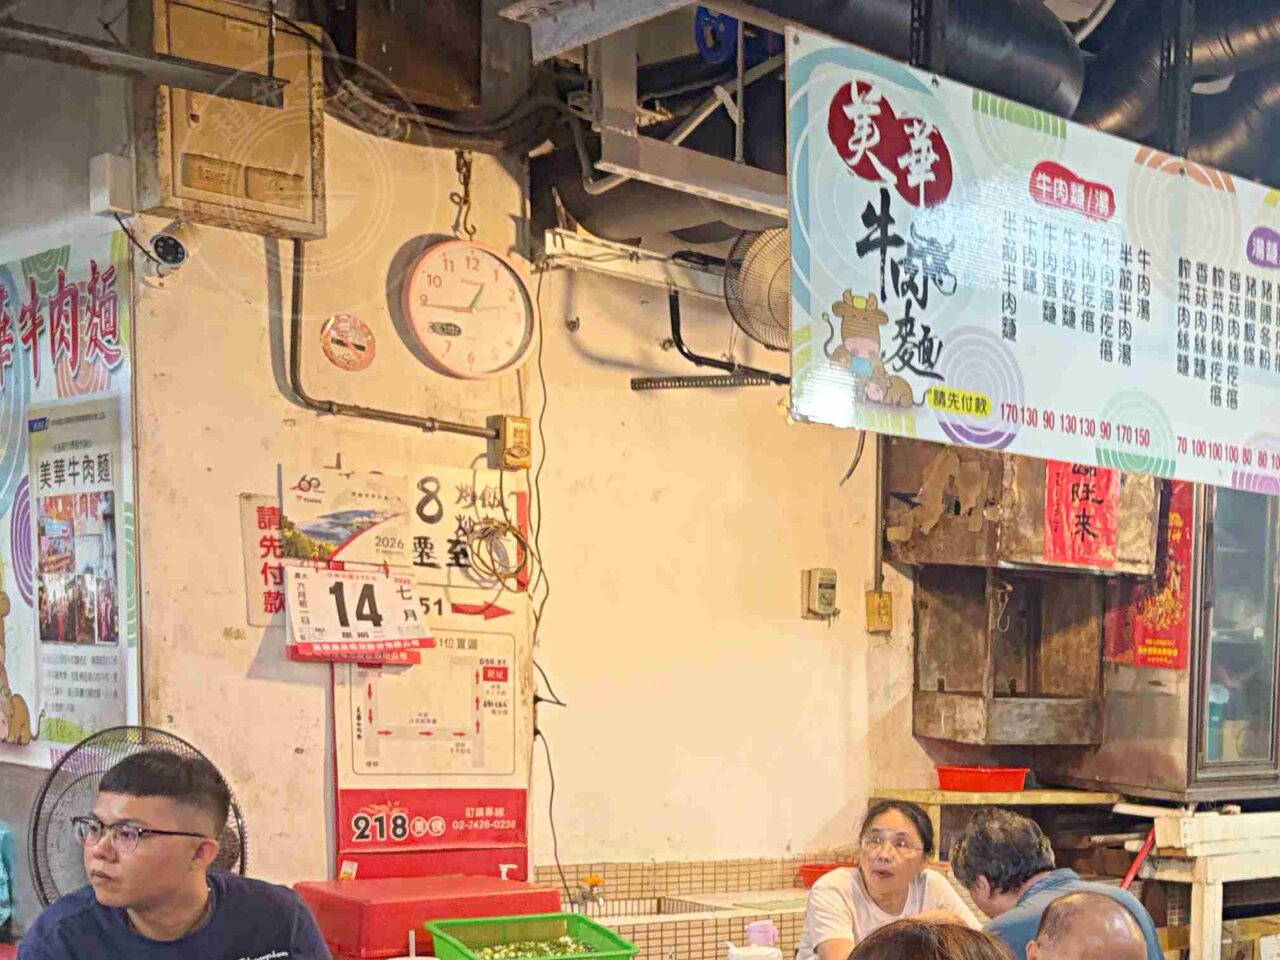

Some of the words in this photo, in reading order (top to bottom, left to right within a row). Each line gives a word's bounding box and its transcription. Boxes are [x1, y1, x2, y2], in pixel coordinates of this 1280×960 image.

[443, 259, 455, 272] 11
[465, 256, 480, 271] 12
[1023, 215, 1038, 294] 牛肉麵
[427, 274, 442, 288] 10
[1137, 247, 1151, 322] 牛肉湯
[933, 389, 988, 415] 請先付款
[1001, 401, 1018, 423] 170
[1020, 405, 1038, 427] 130
[1043, 410, 1055, 430] 90
[1060, 413, 1077, 434] 130
[1080, 418, 1096, 437] 130
[1100, 422, 1111, 440] 90
[1116, 424, 1132, 444] 170
[1134, 428, 1150, 447] 150
[1177, 436, 1188, 454] 70
[1192, 439, 1206, 457] 100
[1208, 442, 1222, 460] 100
[1225, 445, 1238, 463] 100
[1242, 448, 1252, 466] 80
[1257, 451, 1268, 469] 80
[39, 453, 112, 490] 美華牛肉麵
[256, 506, 286, 613] 請先付款
[374, 536, 405, 549] 2026
[329, 581, 383, 628] 14
[396, 585, 418, 622] 七月
[352, 813, 408, 841] 218
